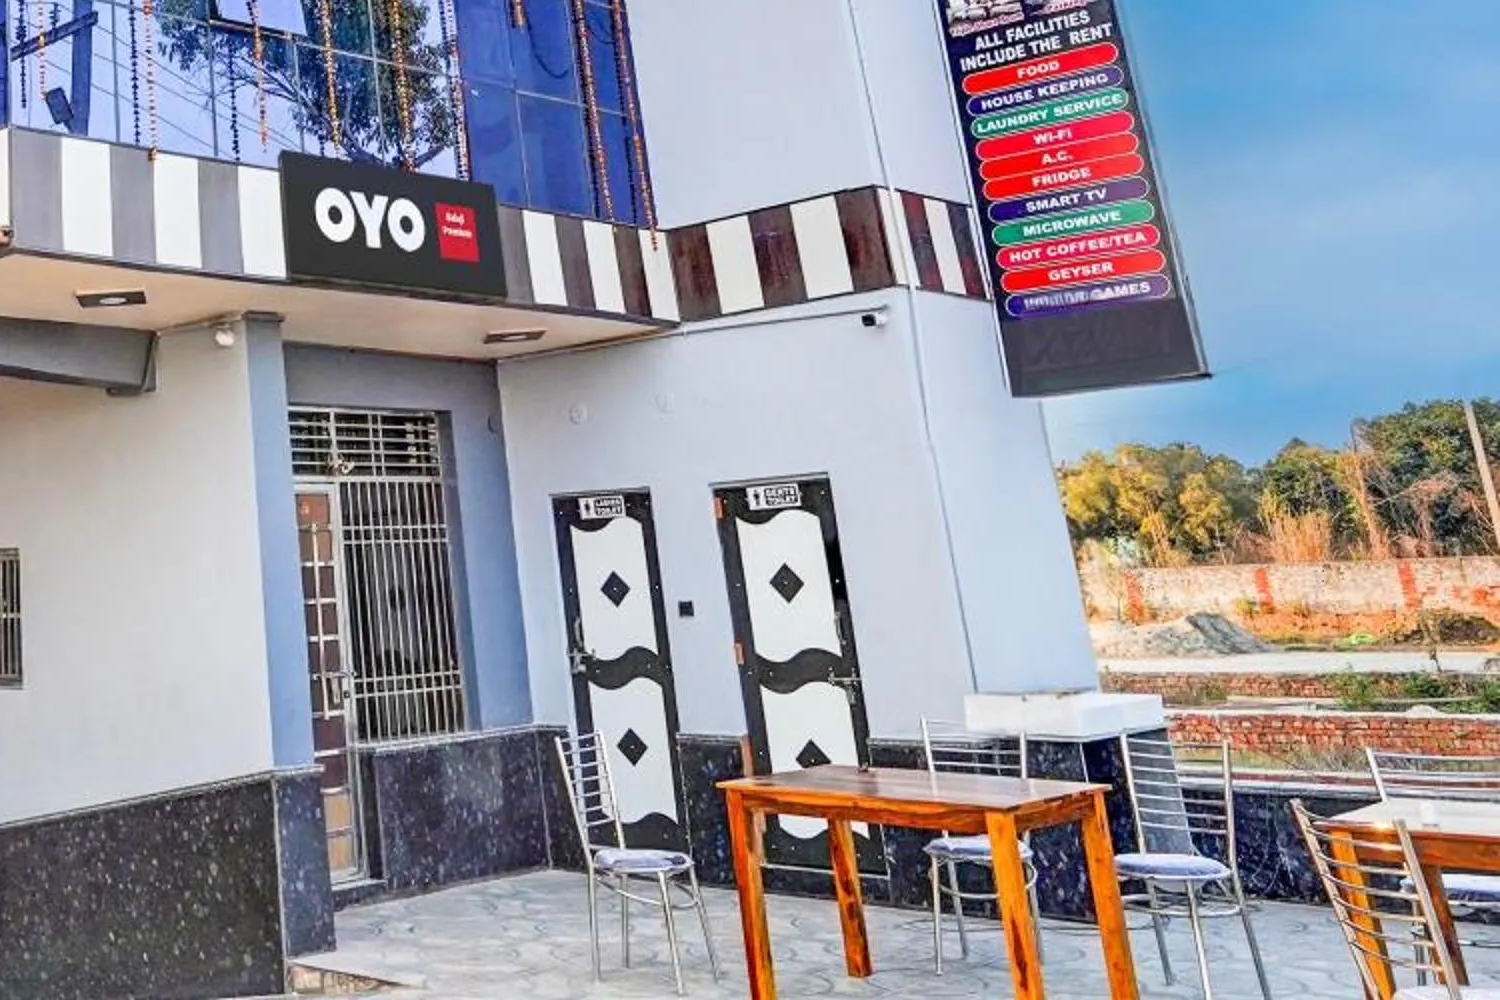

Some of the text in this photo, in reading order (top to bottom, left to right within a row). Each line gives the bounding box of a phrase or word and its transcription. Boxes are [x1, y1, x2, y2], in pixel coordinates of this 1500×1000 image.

[975, 33, 1004, 51] ALL
[1005, 10, 1091, 44] FACILITIES
[960, 22, 1113, 72] INCLUDE THE RENT
[1016, 60, 1060, 79] FOOD
[980, 73, 1109, 112] HOUSE KEEPING
[977, 93, 1124, 133] LAUNDRY SERVICE
[1041, 151, 1074, 165] A.C.
[1032, 167, 1092, 188] FRIDGE
[1025, 187, 1108, 213] SMART TV
[315, 187, 426, 252] OYO
[1023, 211, 1122, 238] MICROWAVE
[1009, 231, 1147, 263] HOT COFFEE/TEA
[1048, 261, 1114, 281] GEYSER
[1089, 280, 1151, 301] GAMES
